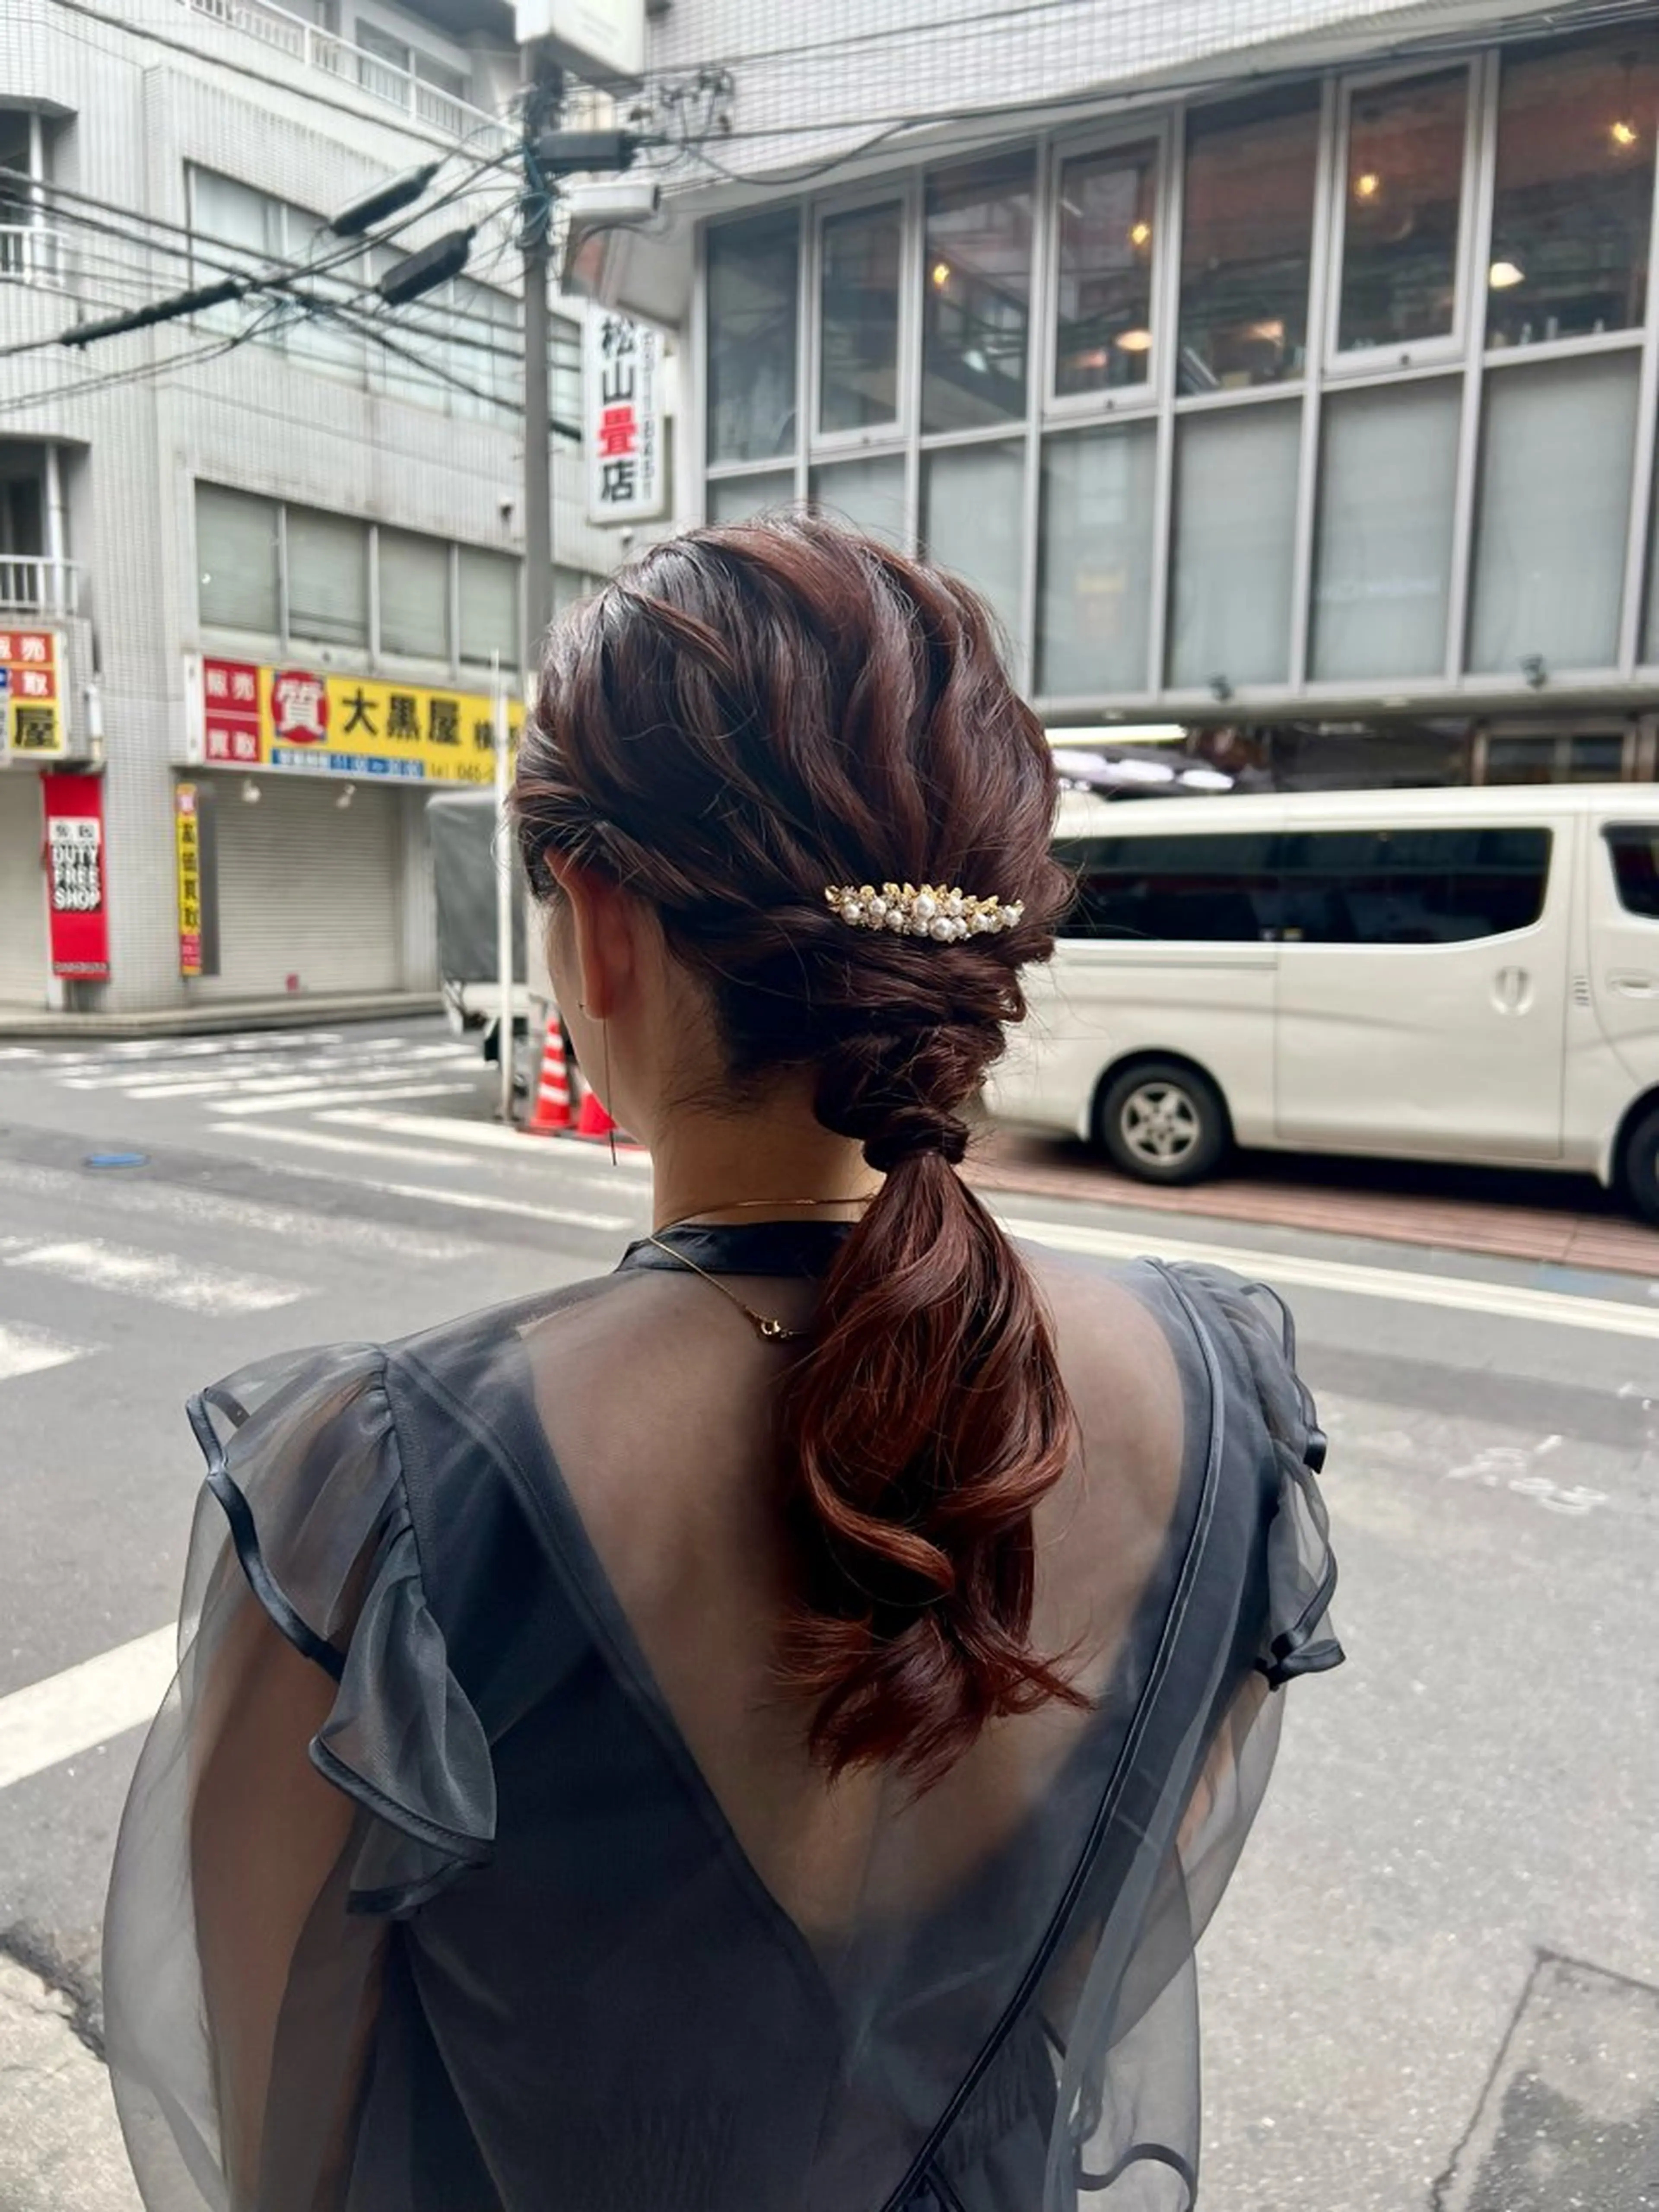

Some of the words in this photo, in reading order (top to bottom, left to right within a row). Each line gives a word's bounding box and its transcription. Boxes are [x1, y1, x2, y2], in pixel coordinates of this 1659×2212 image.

[275, 680, 325, 735] 質
[342, 687, 461, 746] 大黒屋
[51, 845, 99, 864] DUTY
[54, 865, 100, 886] FREE
[53, 887, 101, 911] SHOP
